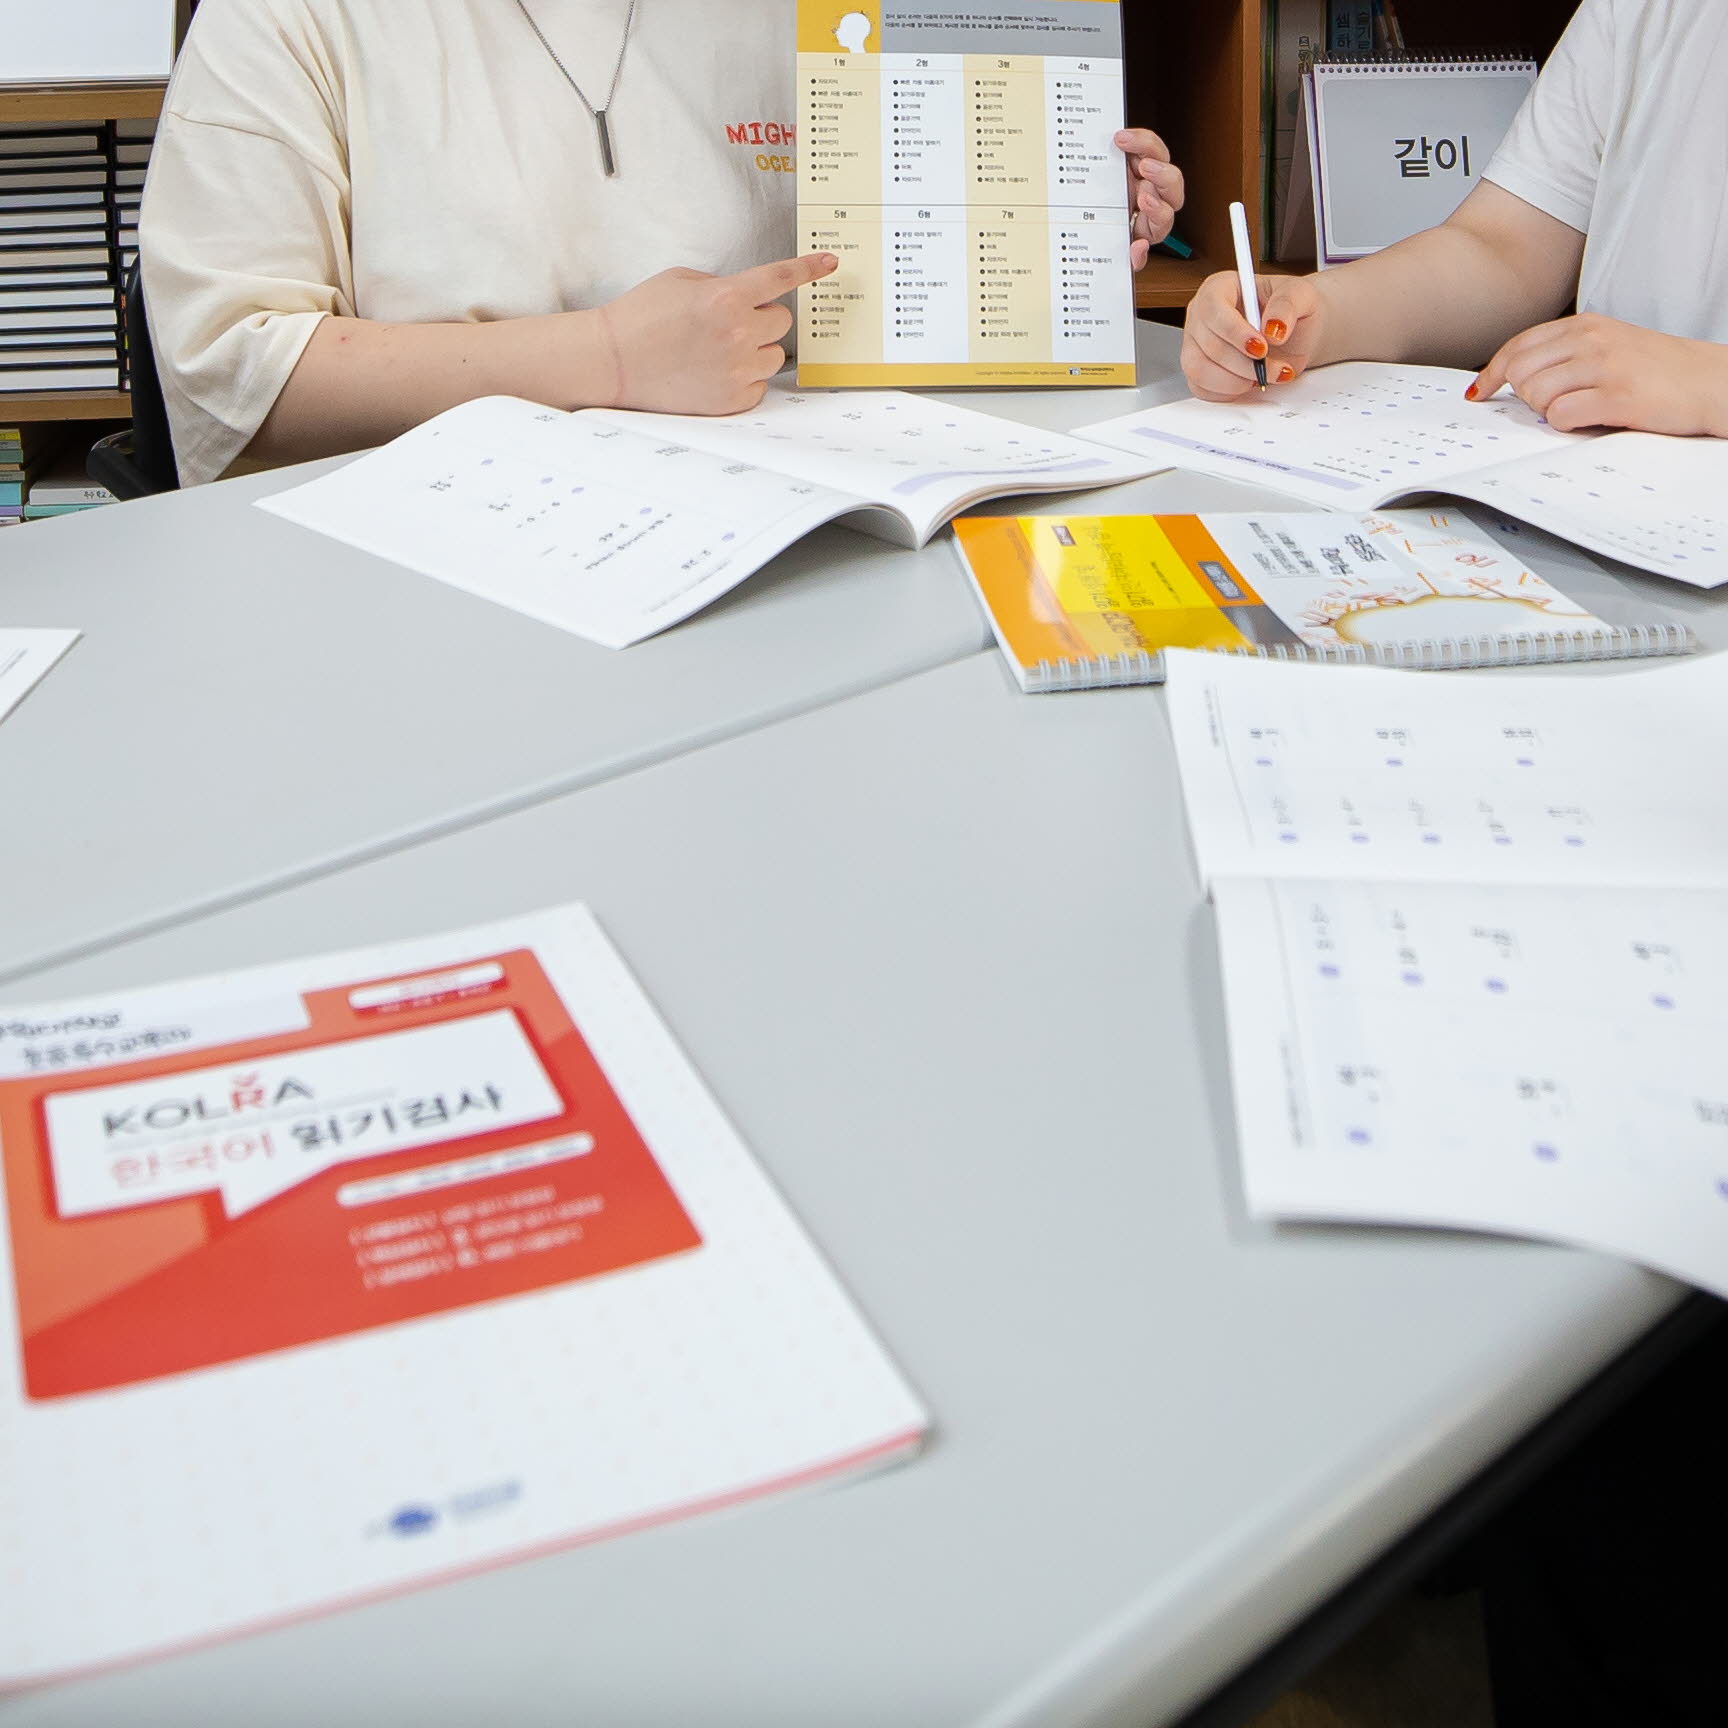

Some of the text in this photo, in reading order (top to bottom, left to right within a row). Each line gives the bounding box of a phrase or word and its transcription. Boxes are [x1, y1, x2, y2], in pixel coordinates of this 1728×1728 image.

[834, 58, 845, 66] 1형
[916, 59, 928, 67] 2형
[998, 60, 1009, 68] 3형
[1078, 63, 1090, 71] 4형
[1394, 135, 1471, 177] 같이
[834, 210, 846, 219] 5형
[918, 210, 930, 219] 6형
[1002, 210, 1014, 219] 7형
[1083, 212, 1095, 220] 8형
[108, 1130, 278, 1189] 한국어
[288, 1082, 503, 1153] 읽기검사
